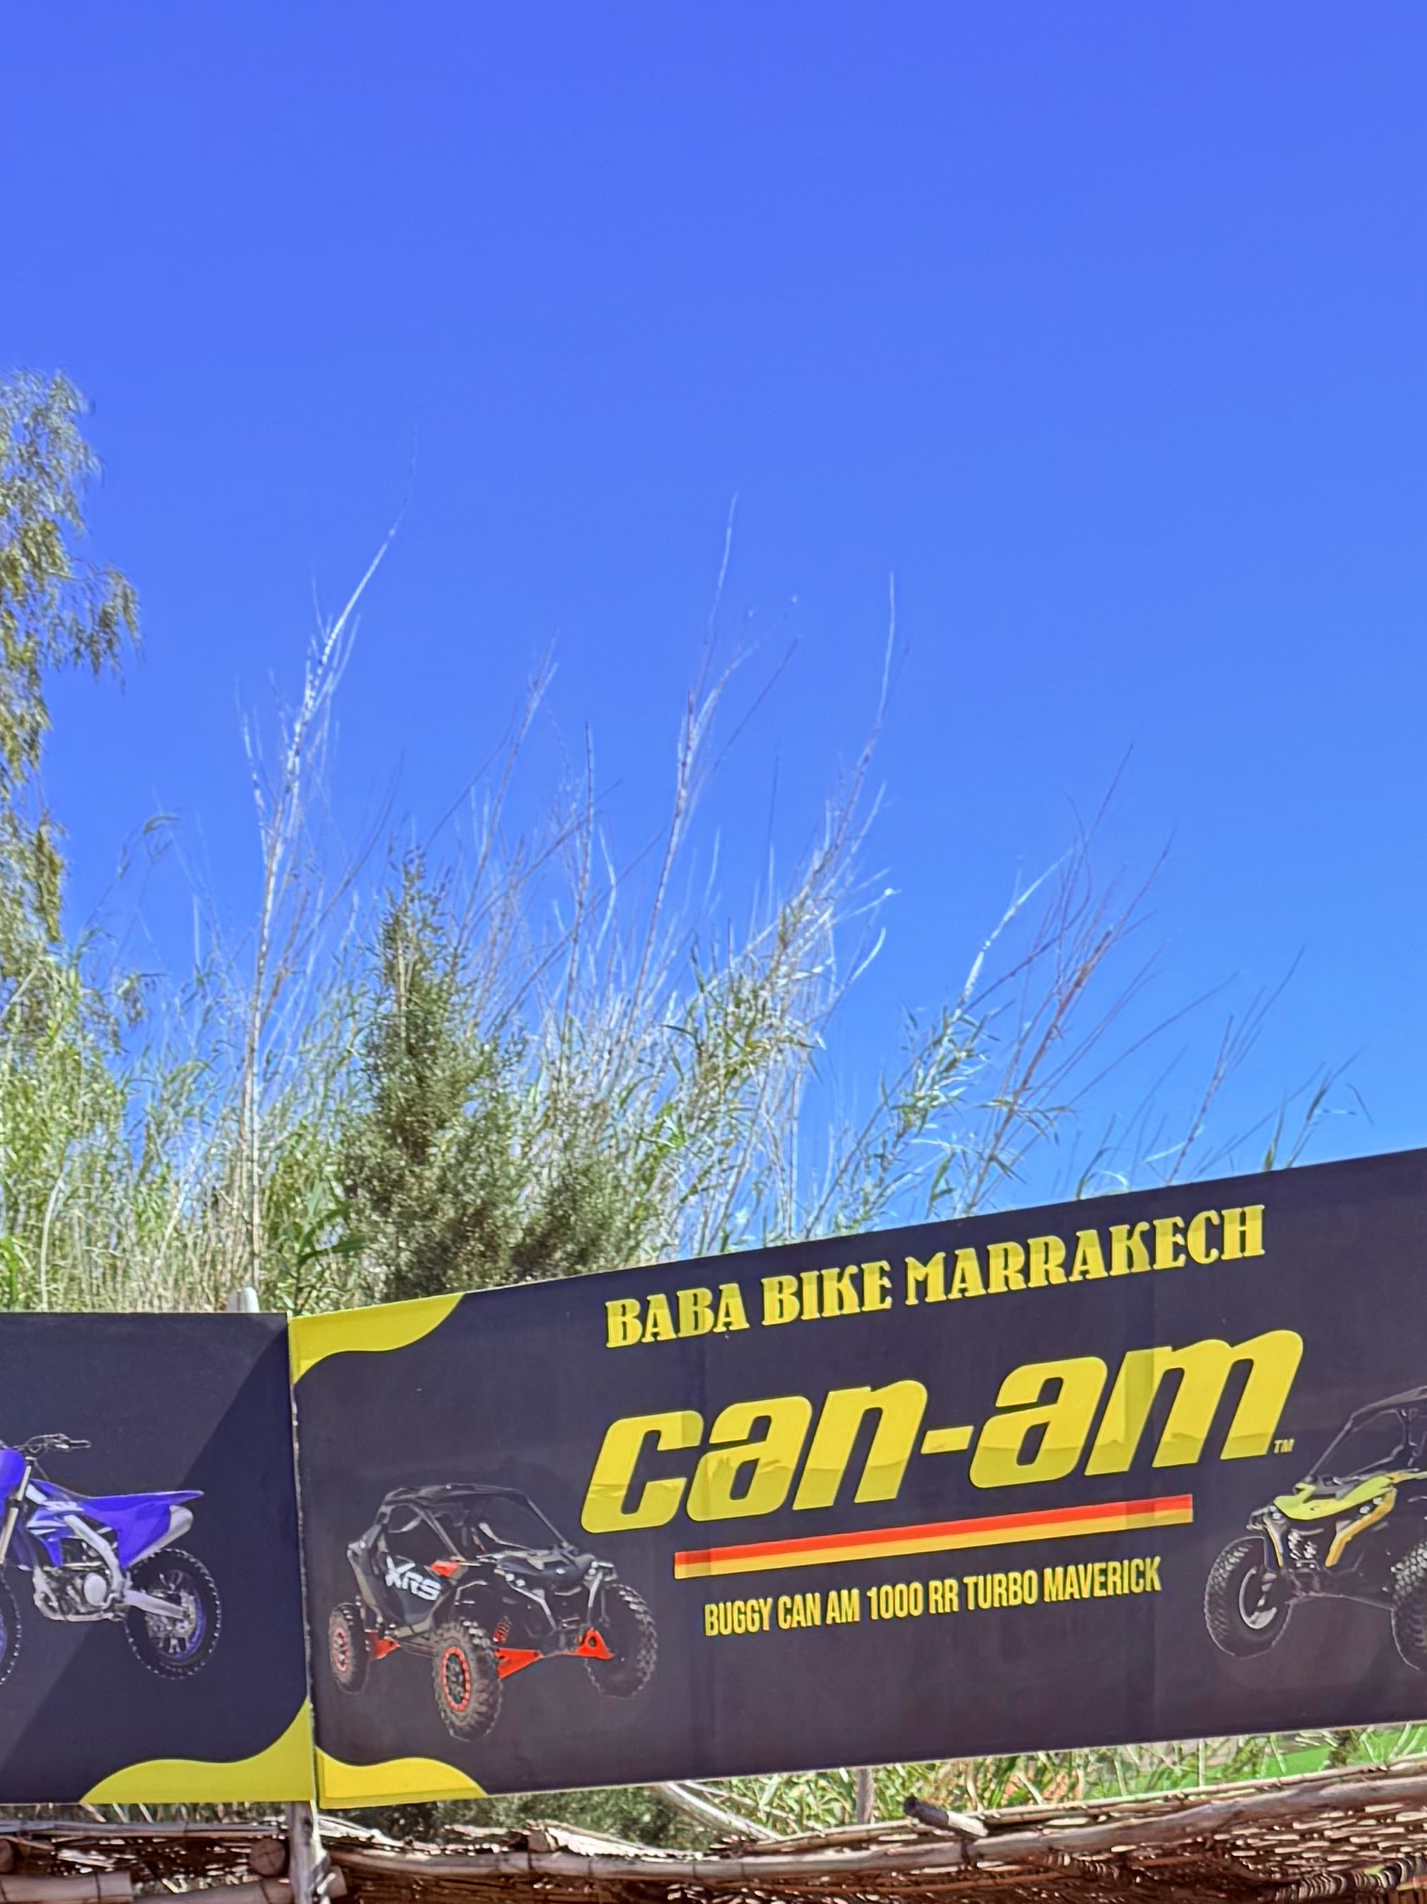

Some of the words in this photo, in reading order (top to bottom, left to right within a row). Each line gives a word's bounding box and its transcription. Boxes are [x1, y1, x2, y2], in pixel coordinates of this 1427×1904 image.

[605, 1283, 749, 1349] BABA
[761, 1261, 892, 1327] BIKE
[904, 1205, 1265, 1307] MARRAKECH
[581, 1329, 1304, 1534] can-am
[385, 1555, 441, 1601] XRS
[704, 1598, 773, 1637] BUGGY
[777, 1592, 822, 1630] CAN
[825, 1589, 861, 1625] AM
[866, 1582, 924, 1621] 1000
[928, 1579, 960, 1615] RR
[962, 1570, 1039, 1611] TURBO
[1043, 1556, 1162, 1603] MAVERICK
